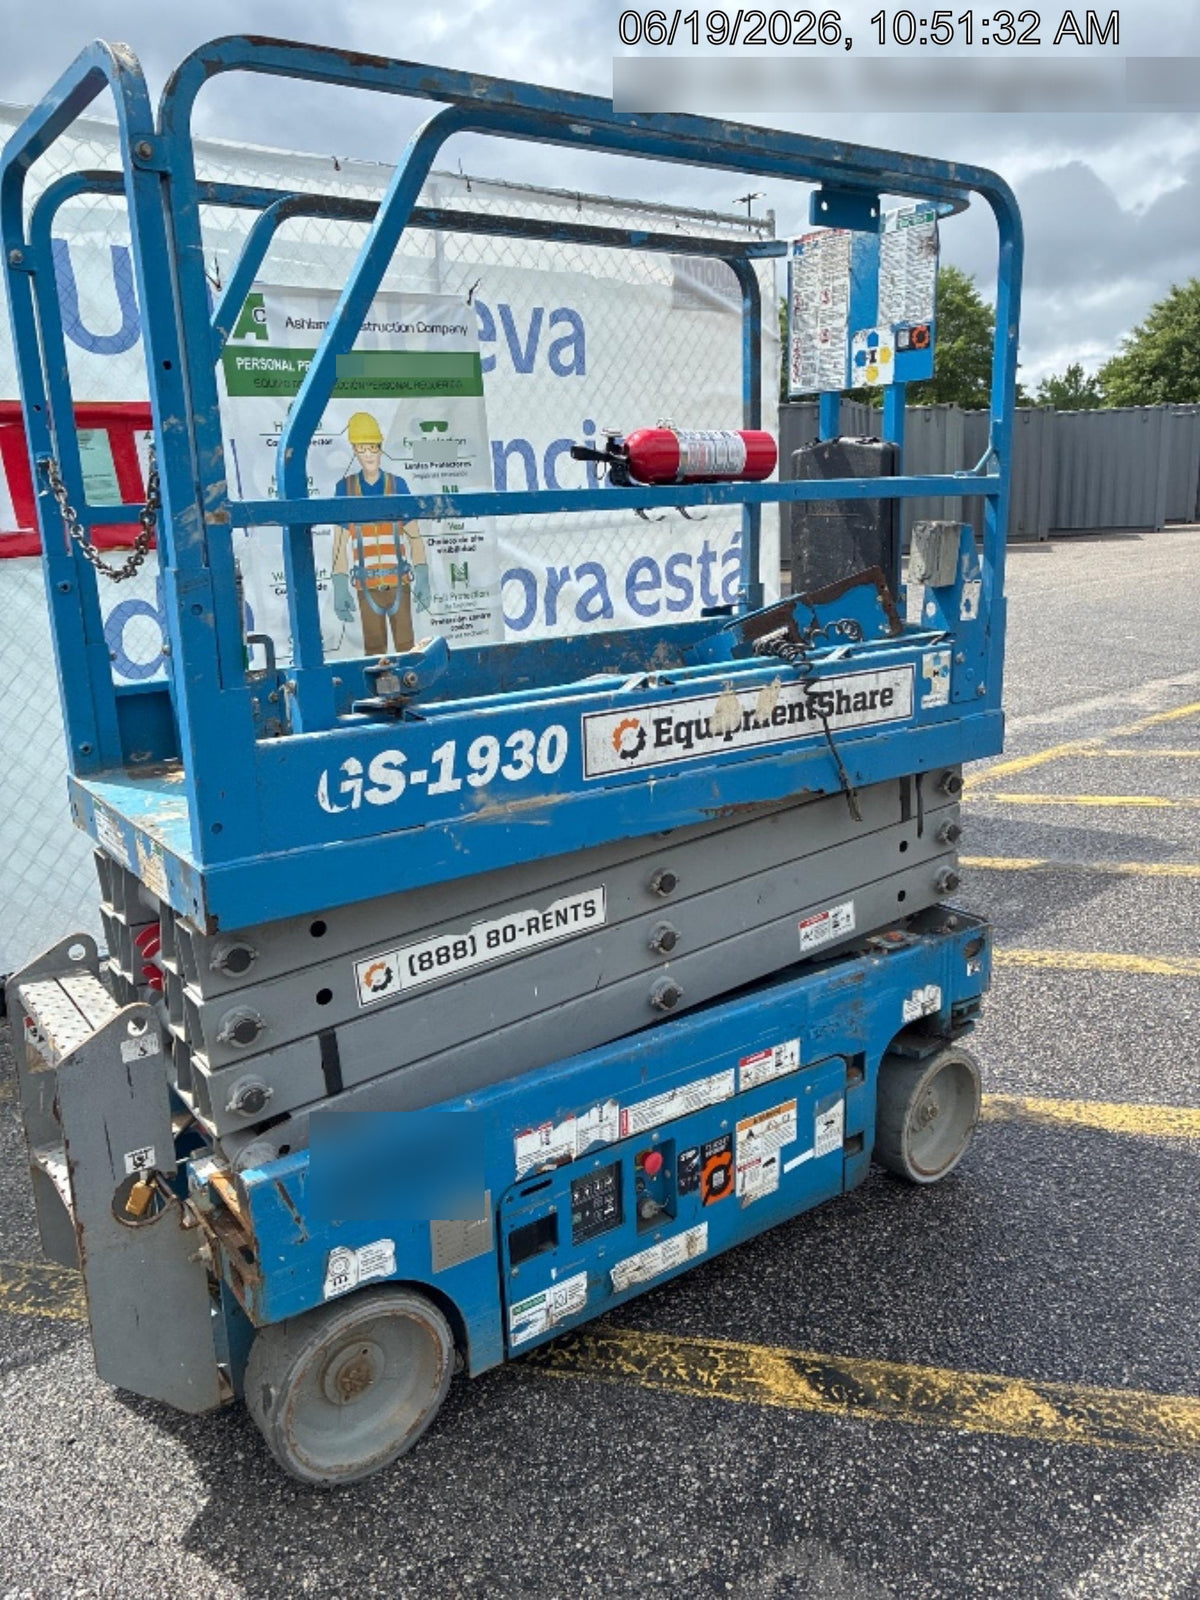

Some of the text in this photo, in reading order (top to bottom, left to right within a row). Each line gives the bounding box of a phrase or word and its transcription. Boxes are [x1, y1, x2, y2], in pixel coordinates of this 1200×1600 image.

[285, 316, 468, 337] Ashlan struction Company
[236, 357, 293, 372] PERSONAL
[317, 724, 568, 813] GS-1930
[408, 899, 596, 976] (888) 80-RENTS
